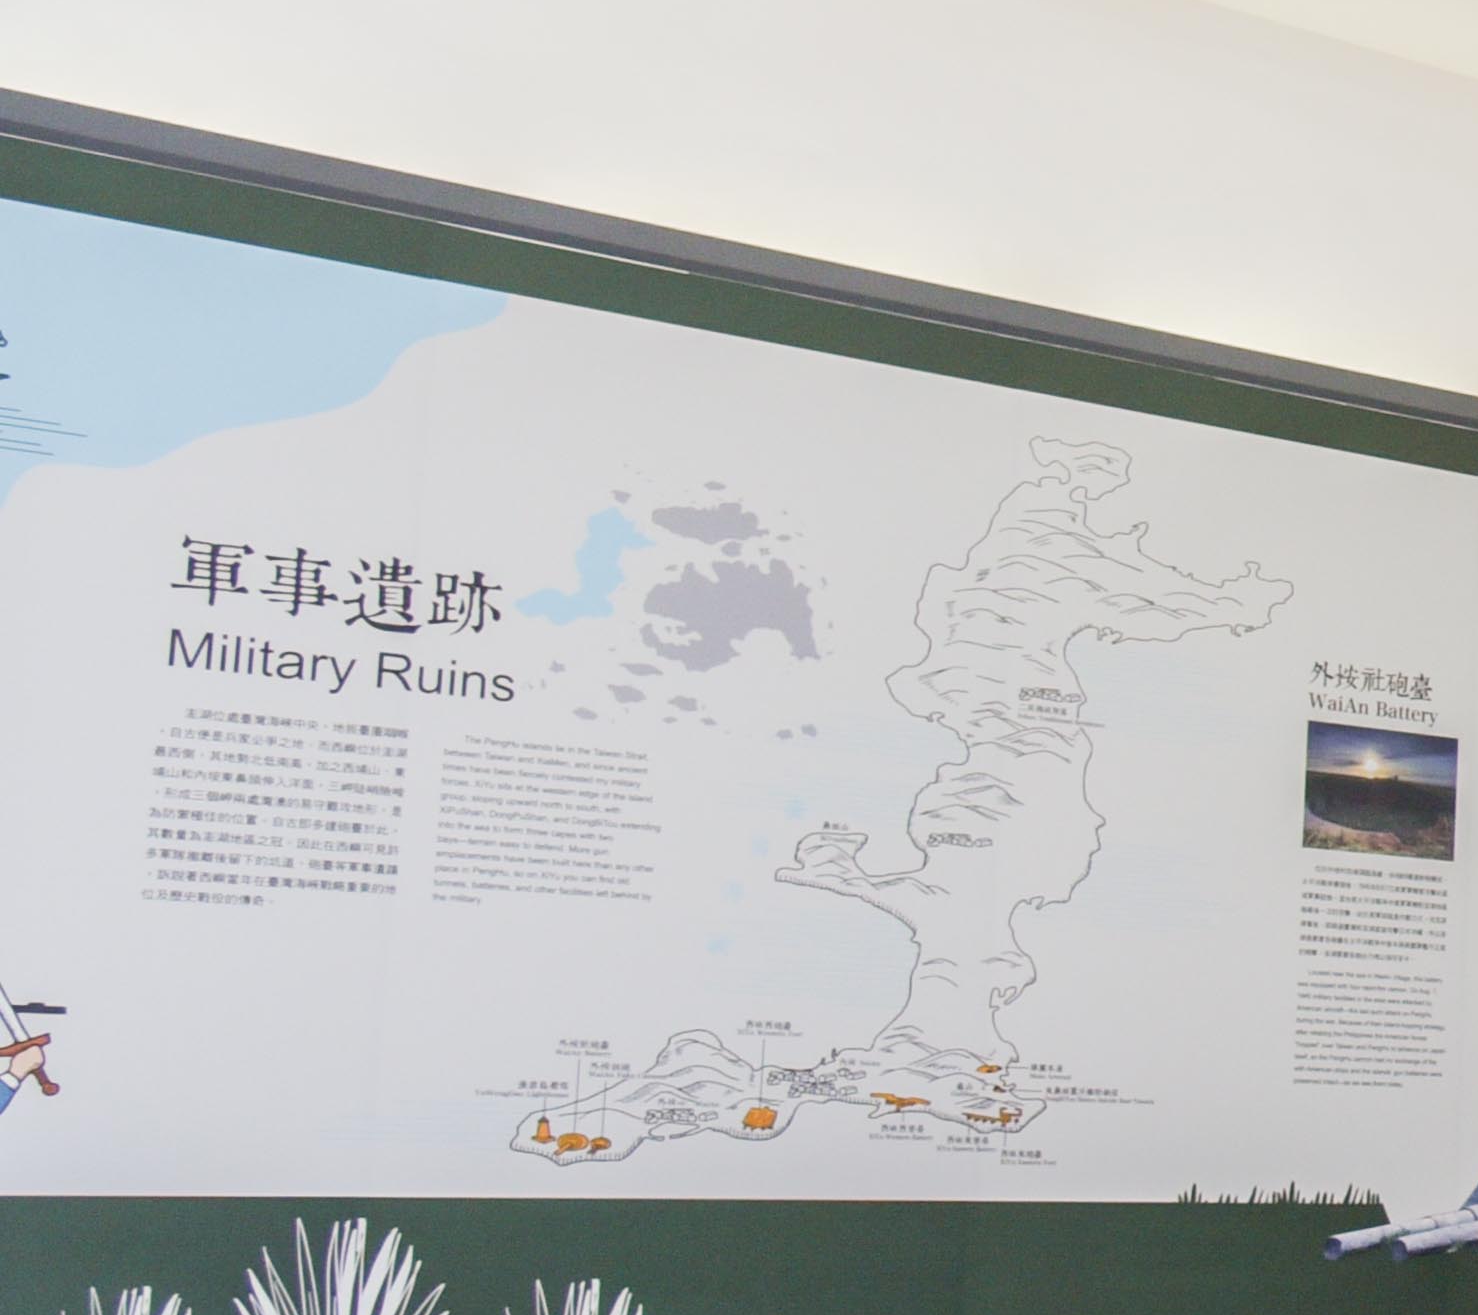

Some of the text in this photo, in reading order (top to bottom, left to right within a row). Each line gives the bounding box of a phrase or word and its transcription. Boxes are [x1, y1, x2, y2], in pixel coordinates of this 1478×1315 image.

[170, 533, 503, 636] 軍事遺跡
[168, 627, 515, 702] Military Ruins
[1308, 692, 1439, 729] WaiAn Battery
